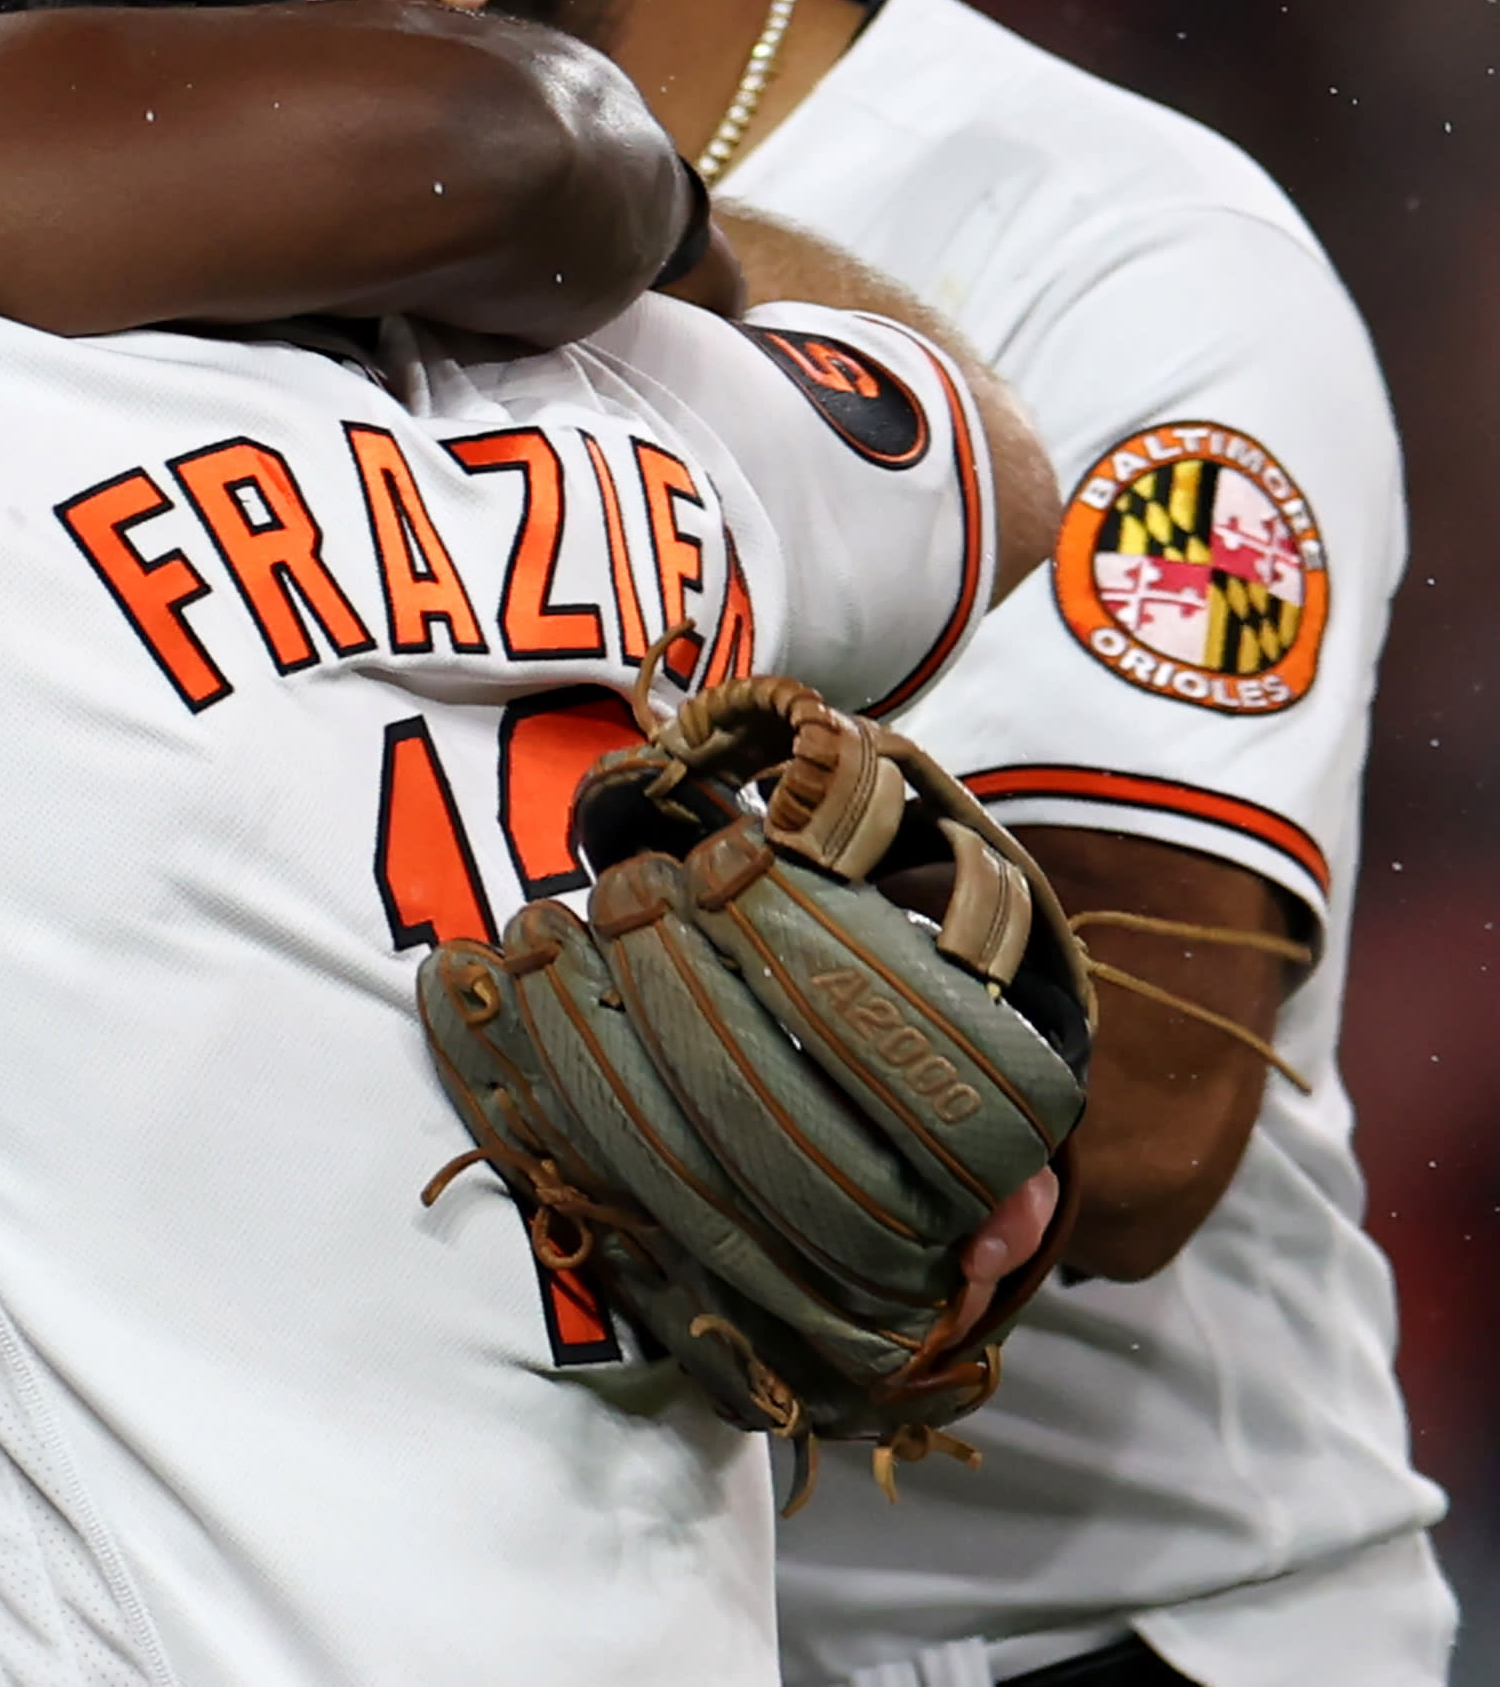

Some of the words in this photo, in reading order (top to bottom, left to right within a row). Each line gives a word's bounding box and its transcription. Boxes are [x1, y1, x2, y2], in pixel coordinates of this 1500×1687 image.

[1080, 427, 1326, 571] BALTIMORE
[1090, 626, 1291, 709] ORIOLES
[810, 968, 984, 1126] A2000
